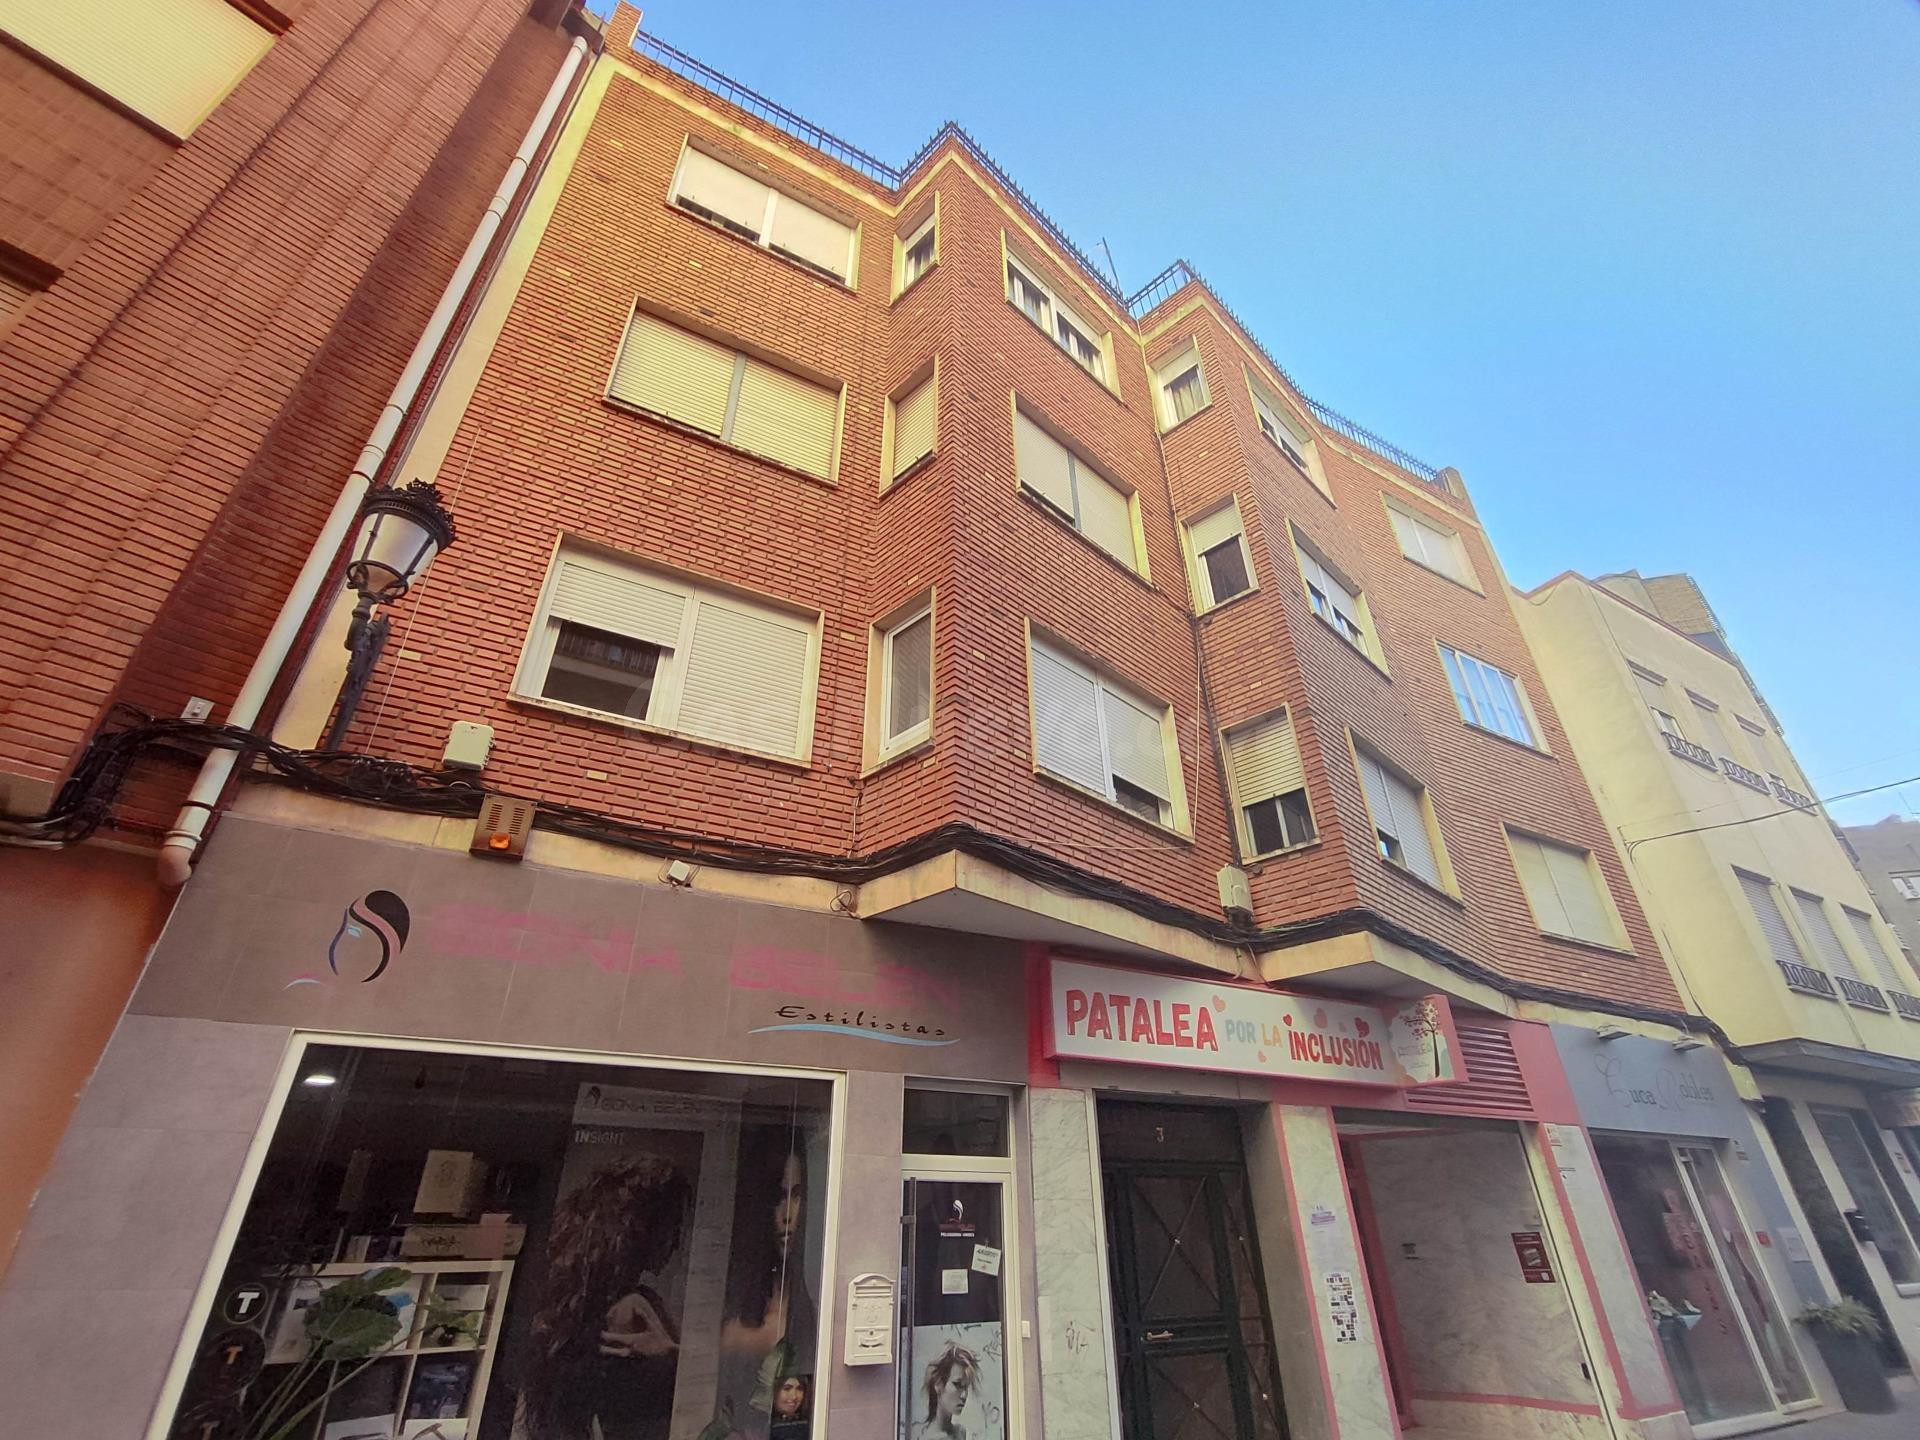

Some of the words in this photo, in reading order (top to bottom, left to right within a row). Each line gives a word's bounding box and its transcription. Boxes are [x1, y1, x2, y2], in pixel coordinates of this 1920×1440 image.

[774, 1005, 945, 1036] Estilistas
[1065, 988, 1219, 1052] PATALEA
[1225, 1018, 1257, 1044] POR
[1260, 1023, 1283, 1048] LA
[574, 1130, 625, 1145] INSIGHT
